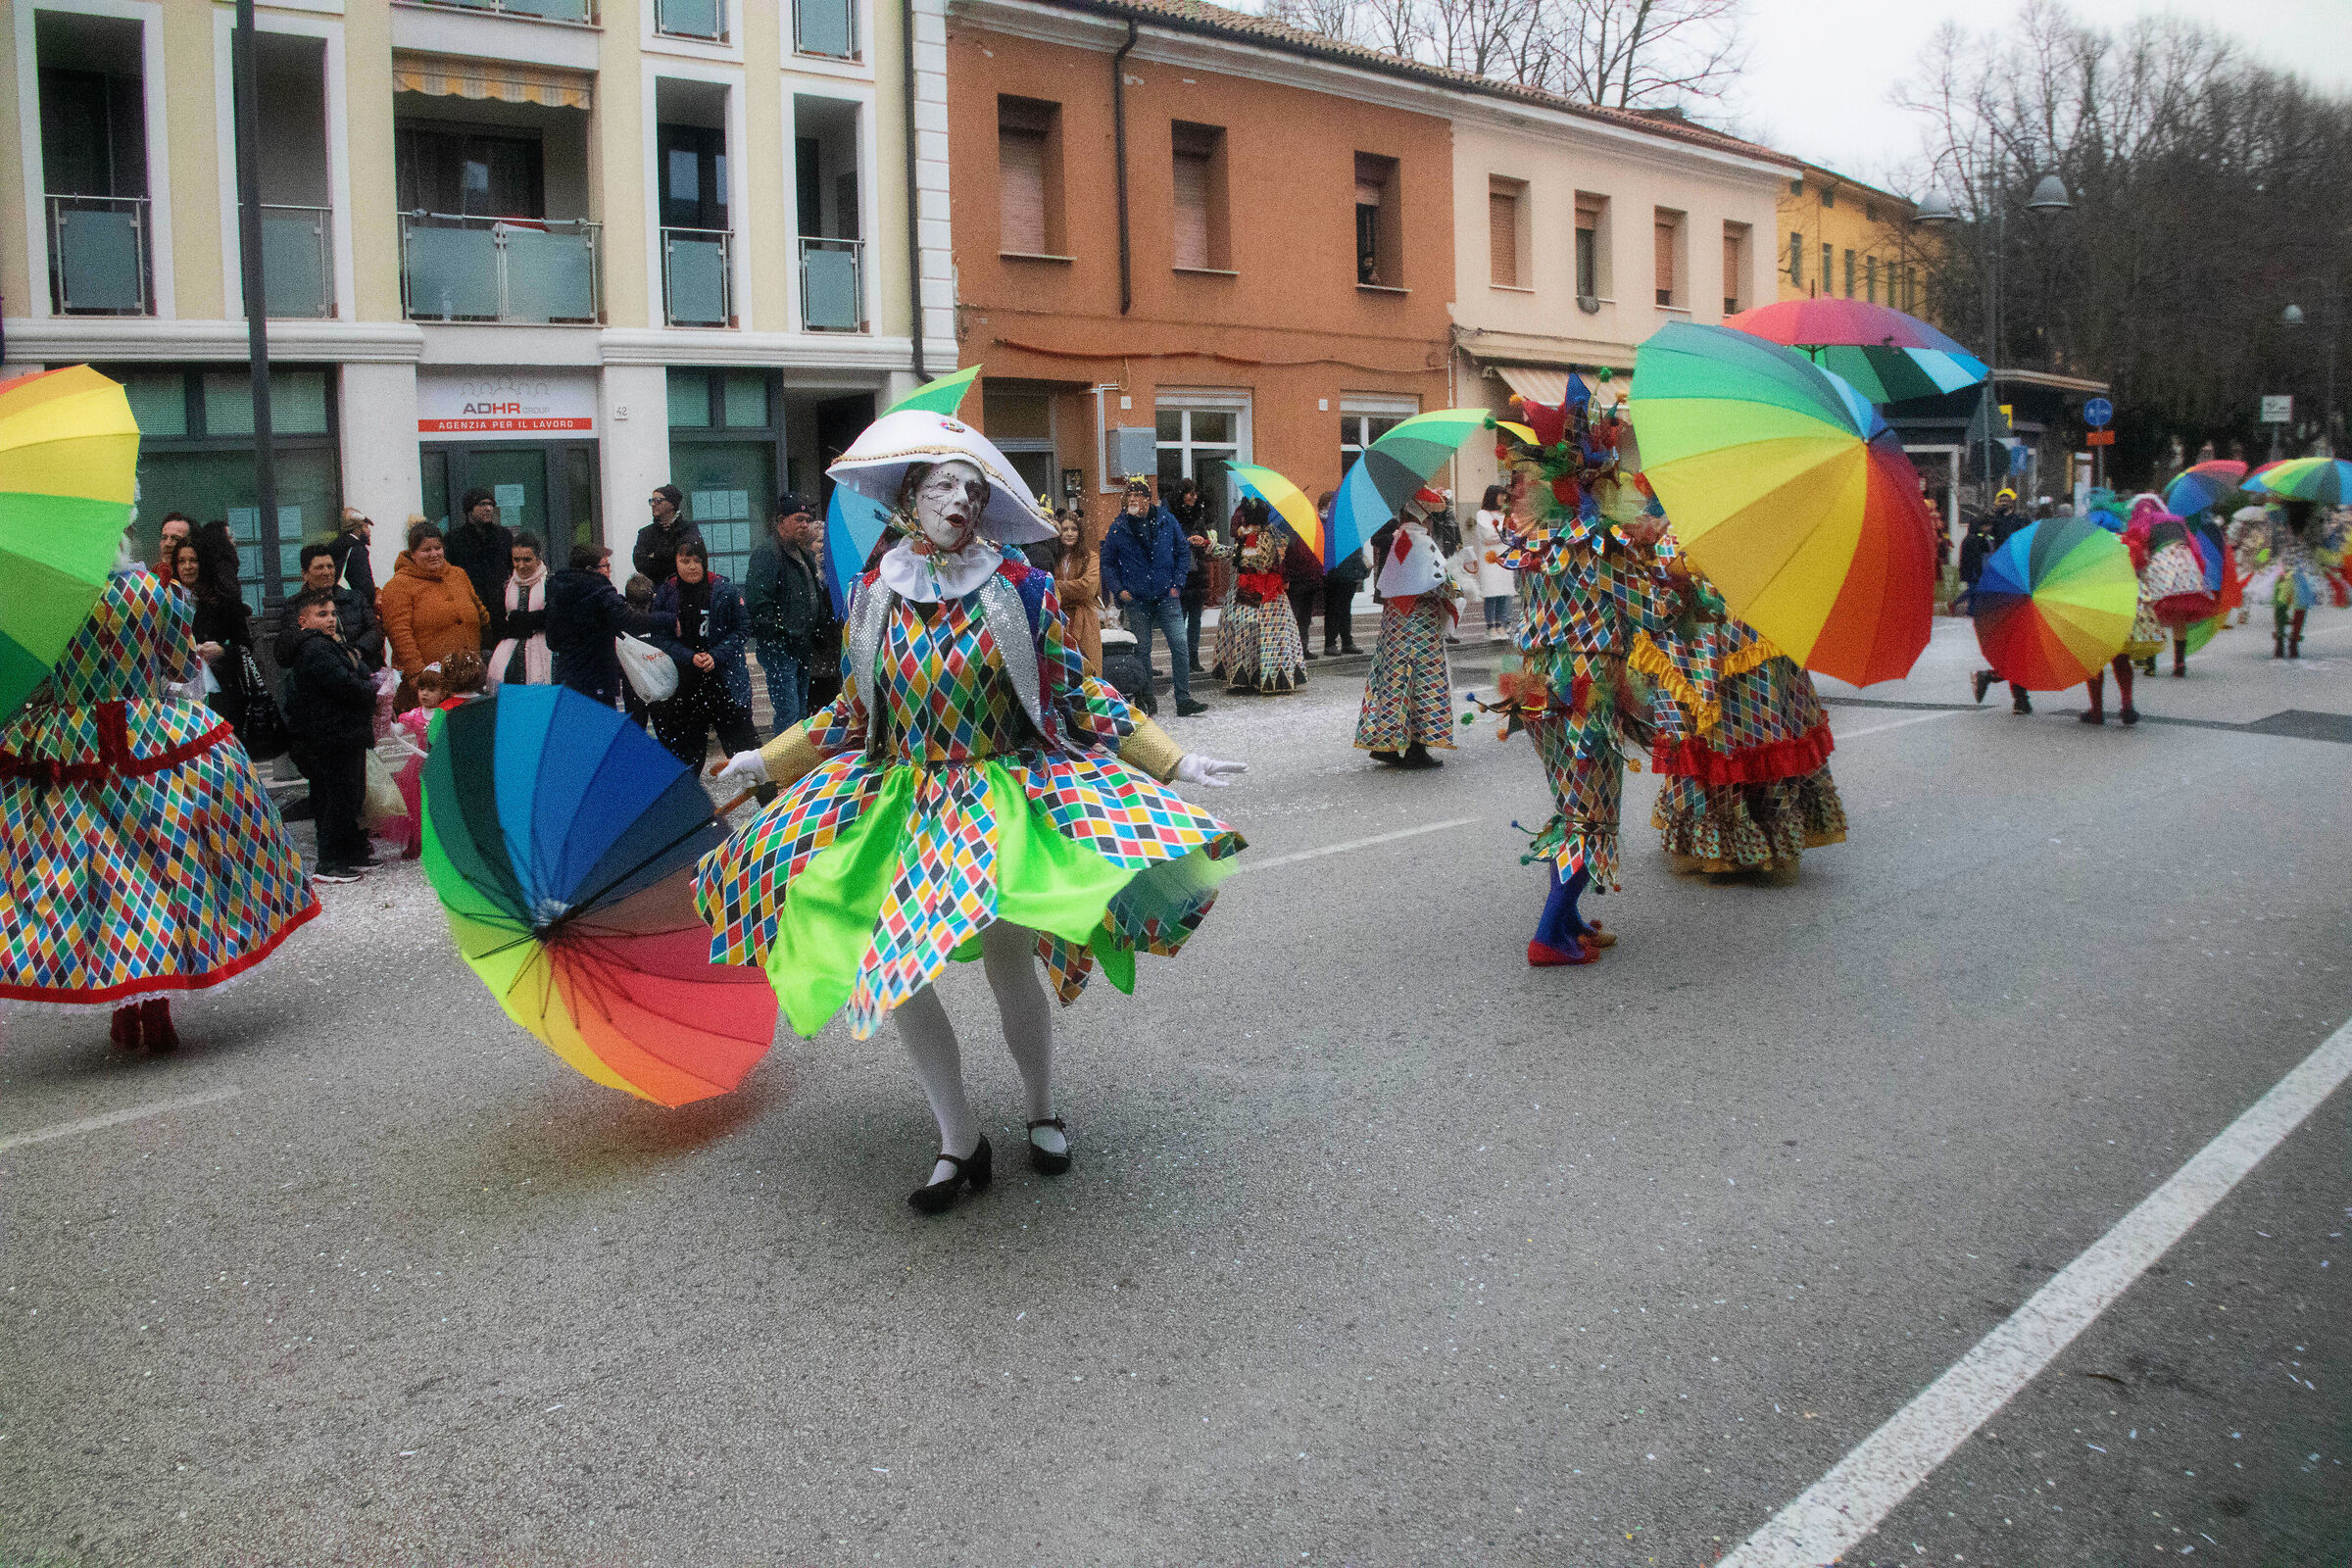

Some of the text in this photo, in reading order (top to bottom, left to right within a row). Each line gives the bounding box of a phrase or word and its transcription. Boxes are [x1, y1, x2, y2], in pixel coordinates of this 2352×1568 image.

[463, 402, 520, 415] ADHR
[616, 407, 627, 416] 42
[438, 421, 487, 430] AGENZIA
[533, 419, 574, 428] LAVORO
